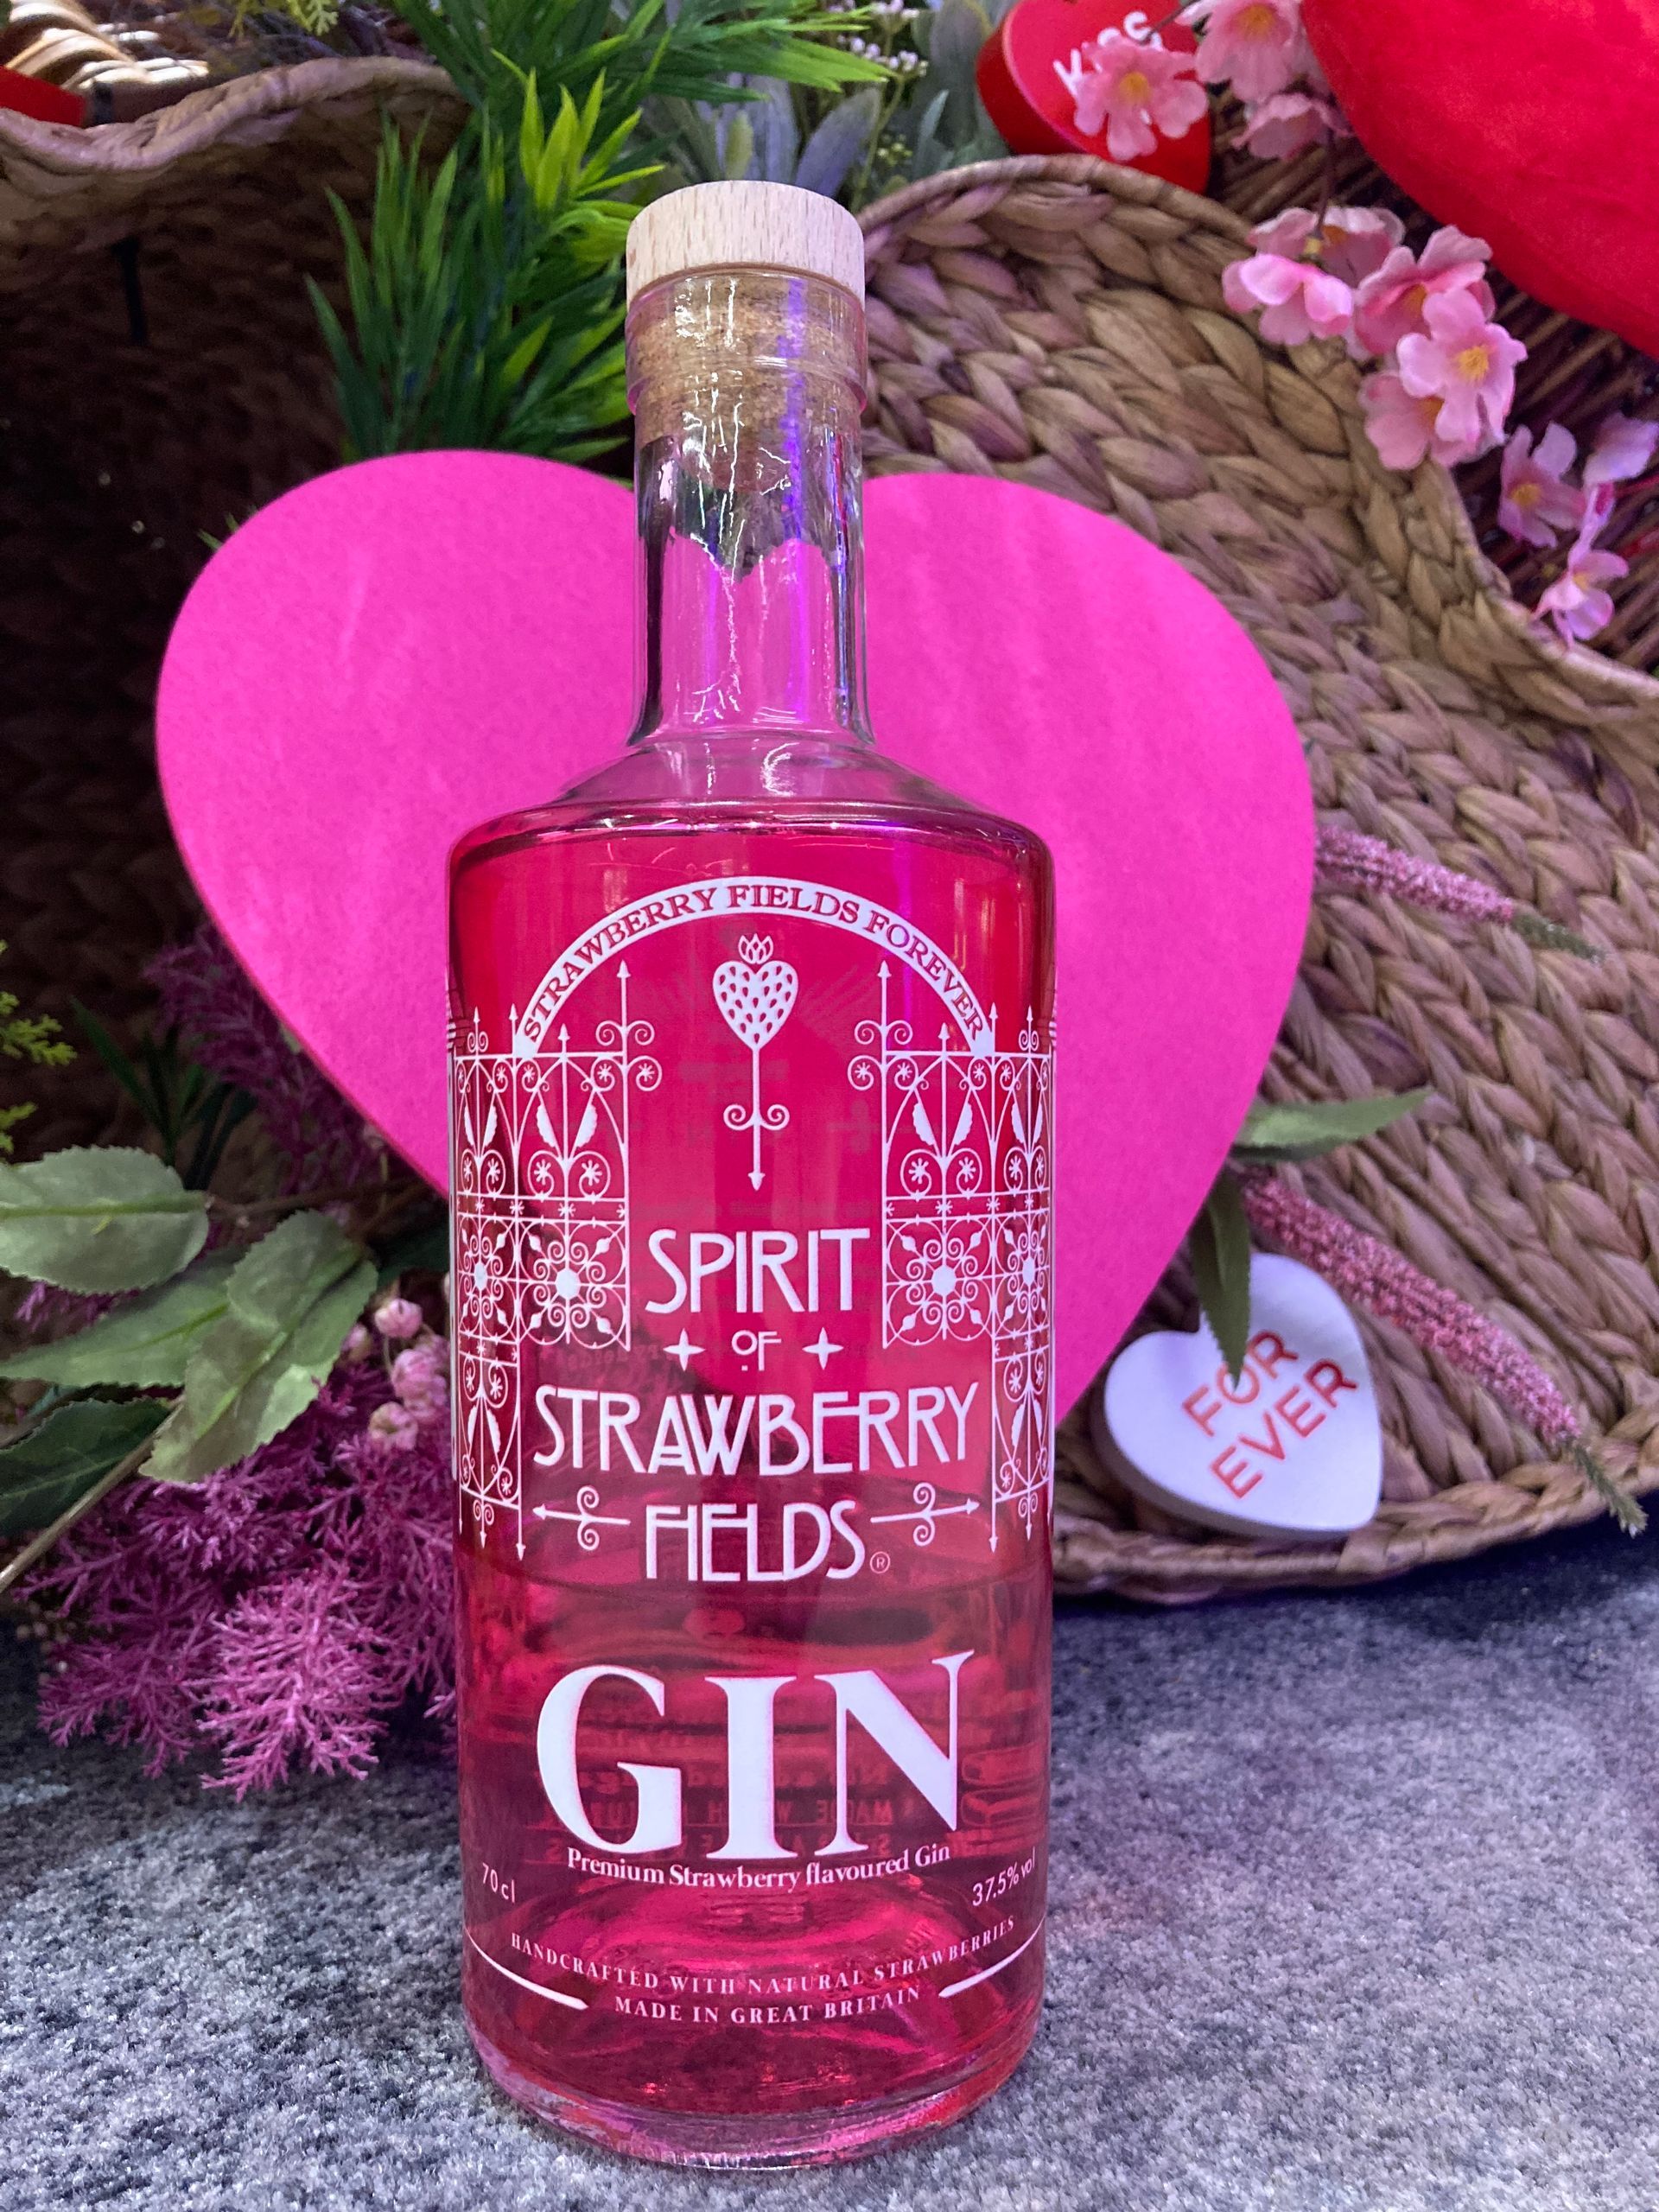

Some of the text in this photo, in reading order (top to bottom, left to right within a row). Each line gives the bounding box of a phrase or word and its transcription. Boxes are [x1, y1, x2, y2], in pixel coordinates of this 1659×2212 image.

[524, 884, 984, 1043] STRAWBERRY FIELDS FOREVER
[645, 1227, 871, 1314] SPIRIT
[730, 1329, 782, 1372] OF
[1181, 1331, 1299, 1437] FOR
[532, 1382, 979, 1477] STRAWBERRY
[1210, 1358, 1358, 1499] EVER
[645, 1499, 866, 1582] FIELDS
[536, 1649, 975, 1859] GIN
[567, 1847, 664, 1885] Premium
[669, 1864, 802, 1894] Strawberry
[805, 1847, 910, 1885] flavoured
[914, 1842, 951, 1868] Gin
[972, 1860, 1020, 1907] 37.5%
[512, 1915, 1015, 1995] HANDCRAFTED WITH NATURAL STRAWBERRIES
[614, 1985, 921, 2024] MADE IN GREAT BRITAIN
